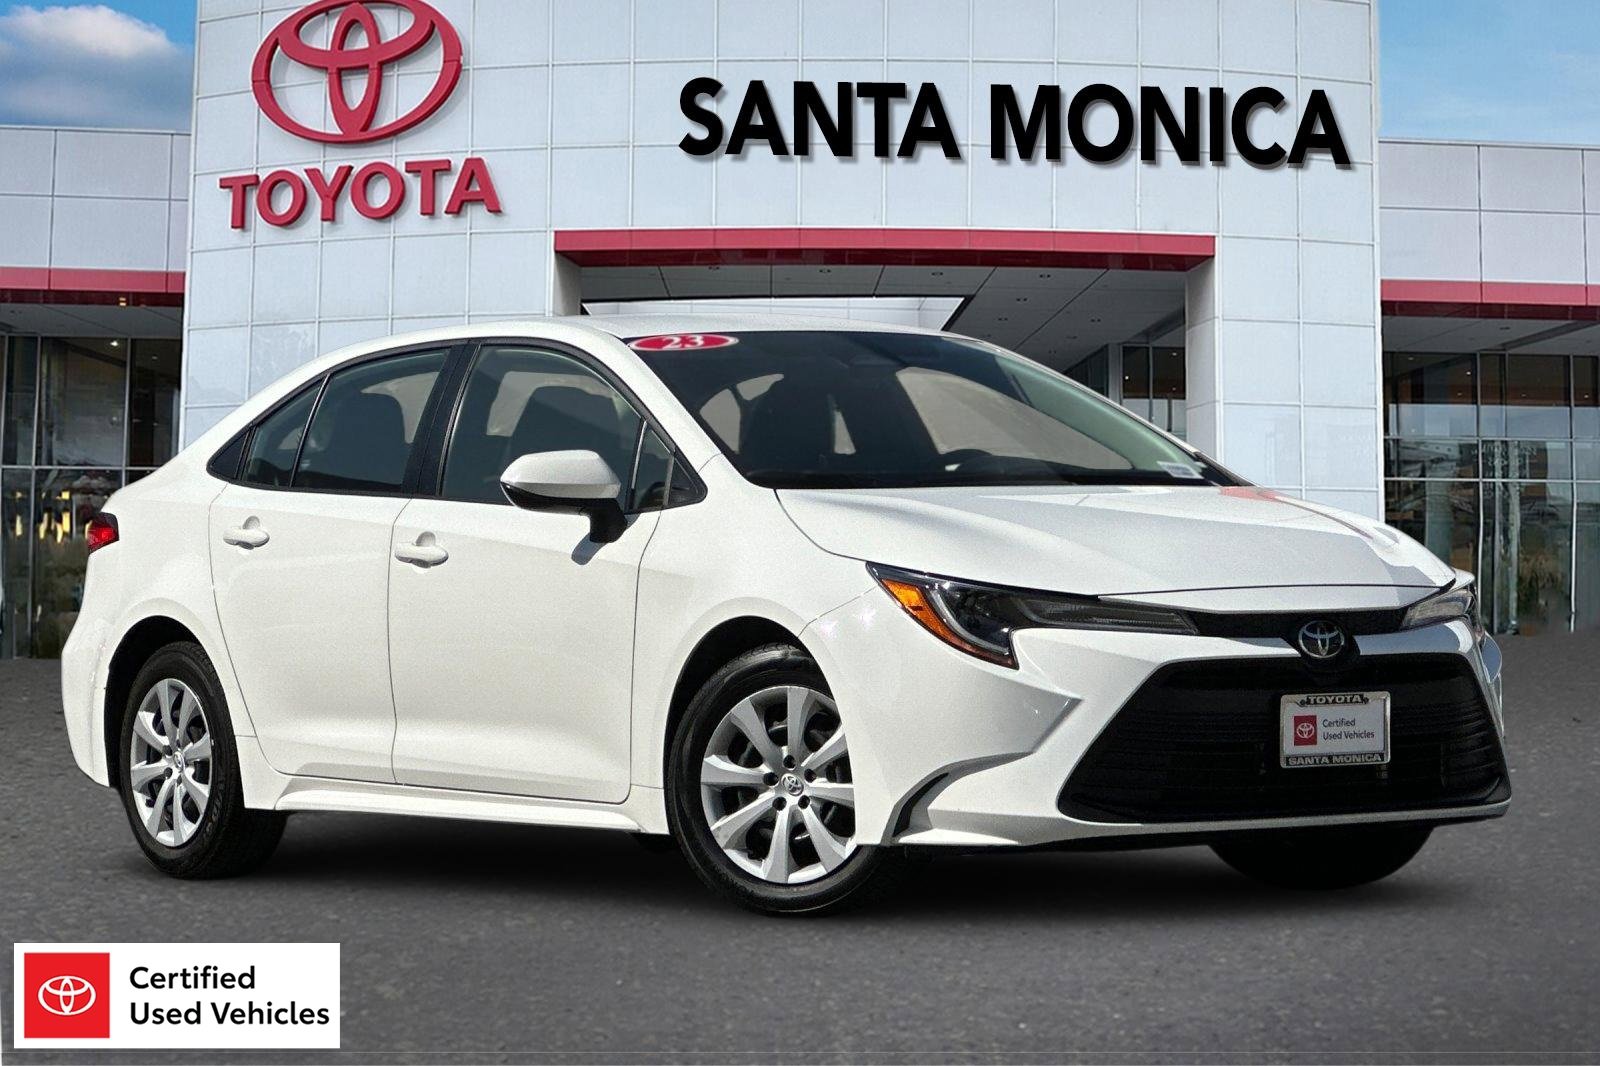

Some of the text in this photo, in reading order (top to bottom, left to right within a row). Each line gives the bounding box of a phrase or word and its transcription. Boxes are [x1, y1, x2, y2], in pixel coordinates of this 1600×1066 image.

[678, 77, 1352, 168] SANTA MONICA
[219, 156, 502, 229] TOYOTA
[661, 334, 705, 349] 23
[1307, 694, 1363, 705] TOYOTA
[1322, 717, 1356, 728] Certified
[1322, 730, 1375, 741] Used Vehicles
[1288, 753, 1382, 766] SANTA MONICA
